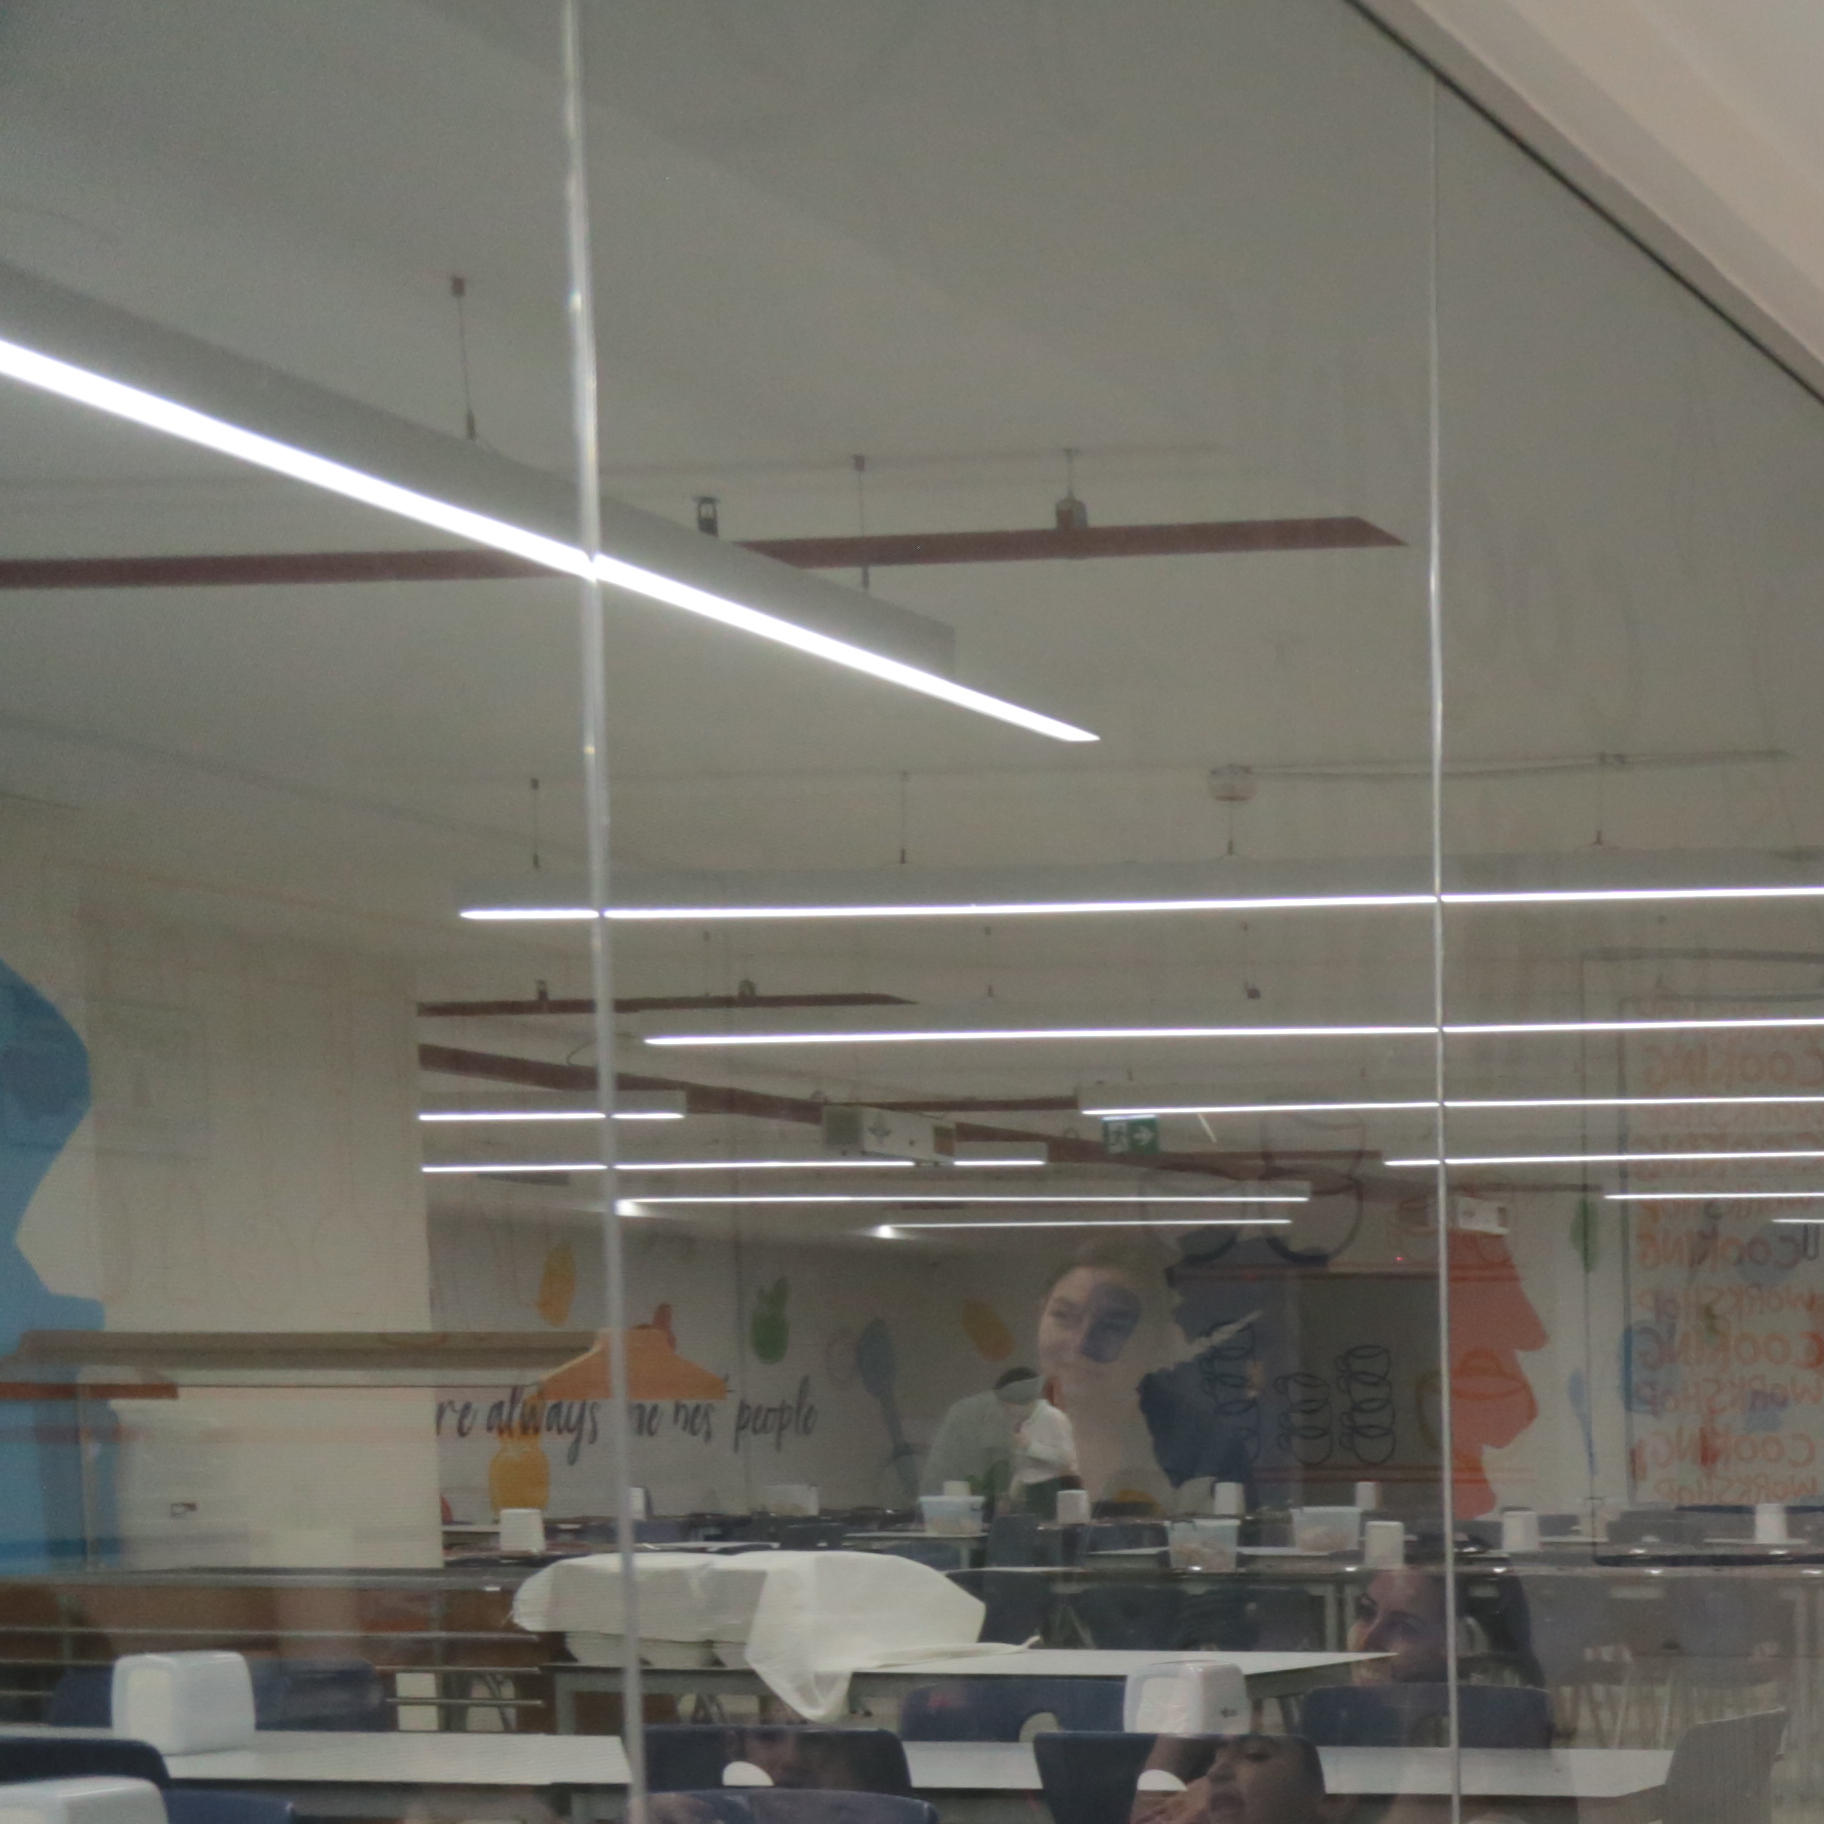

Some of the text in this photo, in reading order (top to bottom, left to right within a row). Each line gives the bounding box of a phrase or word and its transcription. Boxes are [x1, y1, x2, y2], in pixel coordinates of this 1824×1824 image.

[435, 1400, 477, 1439] re
[486, 1385, 599, 1467] always
[628, 1400, 663, 1438] he
[732, 1374, 818, 1454] people
